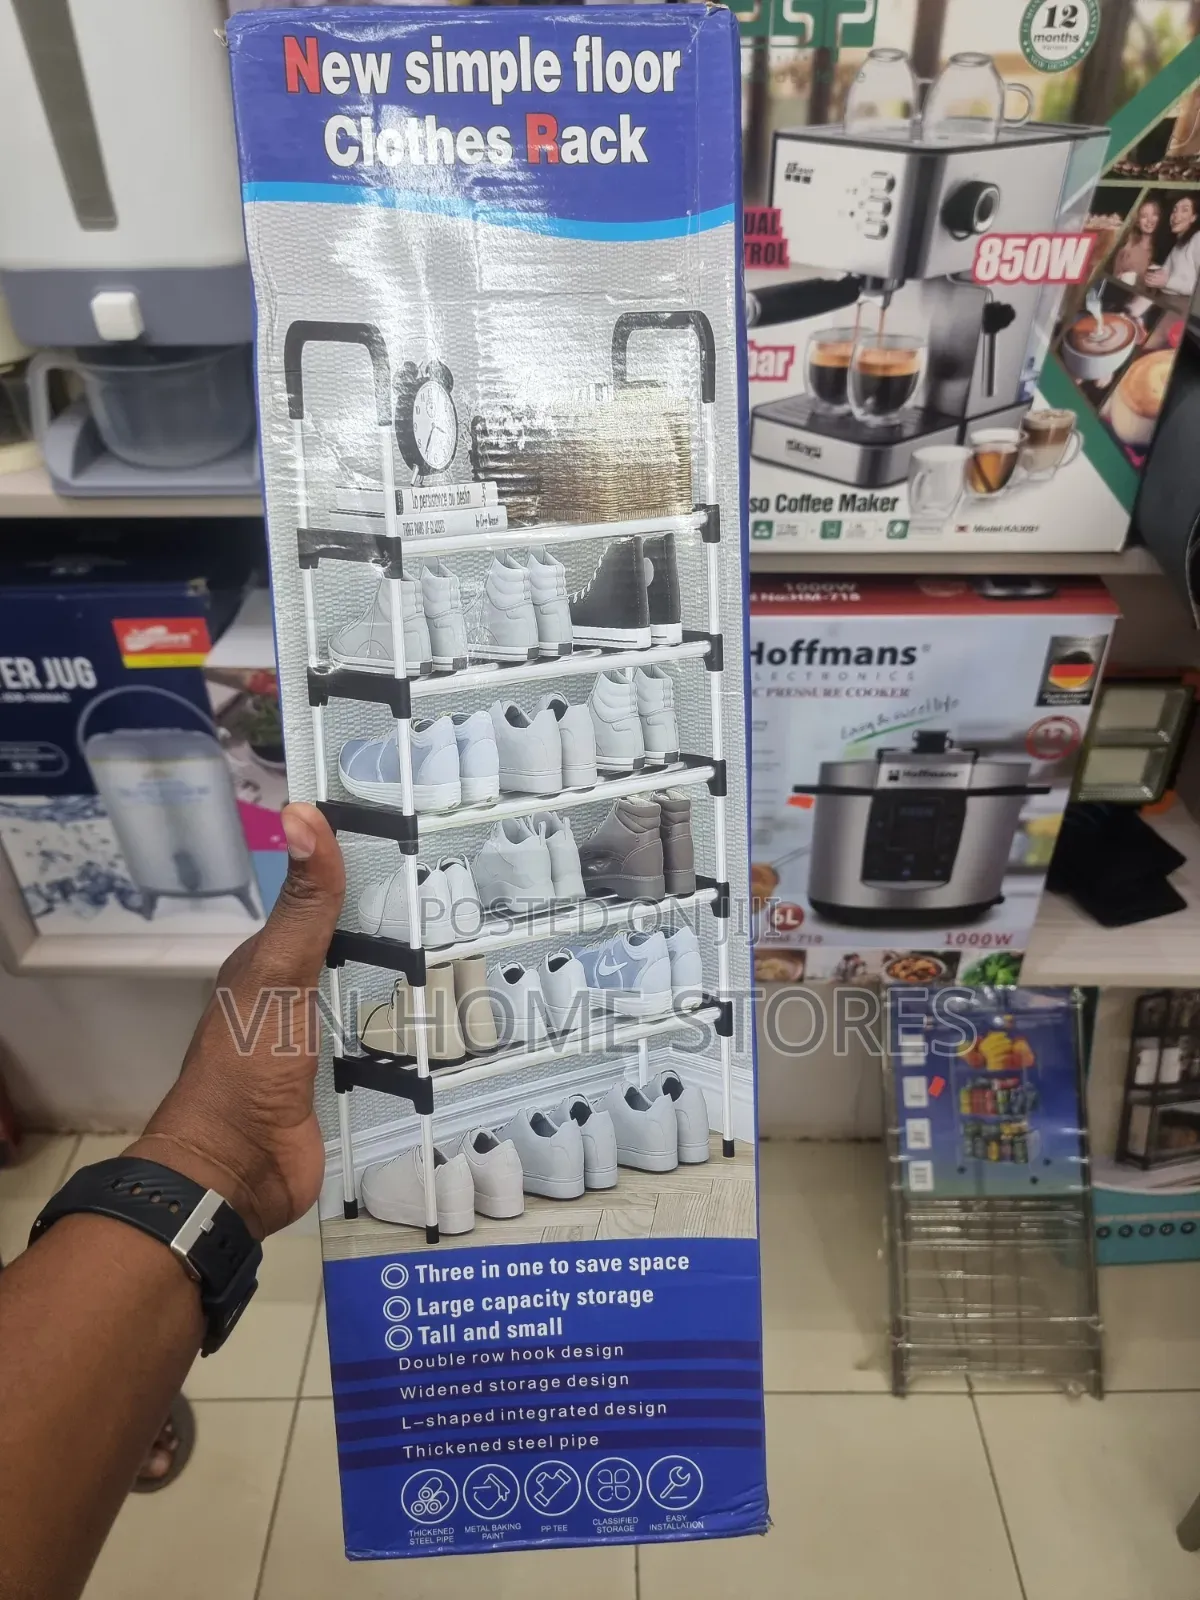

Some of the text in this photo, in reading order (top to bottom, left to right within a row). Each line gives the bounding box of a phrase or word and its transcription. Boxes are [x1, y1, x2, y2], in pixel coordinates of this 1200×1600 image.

[1043, 4, 1079, 29] 12
[1033, 33, 1080, 43] months
[282, 34, 682, 106] New simple floor
[323, 112, 650, 169] Clothes Rack
[975, 235, 1092, 281] 850W
[775, 493, 833, 513] Coffee
[839, 493, 899, 513] Maker
[750, 639, 917, 665] Hoffmans
[43, 656, 97, 689] JUG
[945, 933, 1014, 945] 1000W
[414, 1255, 690, 1284] Three in one to save space
[416, 1288, 654, 1318] Large capacity storage
[418, 1316, 563, 1345] Tall and small
[398, 1344, 624, 1371] Double row hook design
[400, 1373, 629, 1400] Widened storage design
[401, 1401, 667, 1430] L-shaped integrated design
[403, 1434, 599, 1459] Thickened steel pipe
[464, 1522, 522, 1533] METAL BAKING
[540, 1524, 568, 1533] PP TEE
[592, 1516, 639, 1526] CLASSIFIED
[596, 1524, 635, 1534] STORAGE
[649, 1521, 704, 1531] INSTALLATION
[665, 1514, 688, 1523] EASY
[409, 1527, 455, 1537] THICKENED
[409, 1535, 455, 1546] STEEL PIPE
[481, 1532, 505, 1540] PAINT
